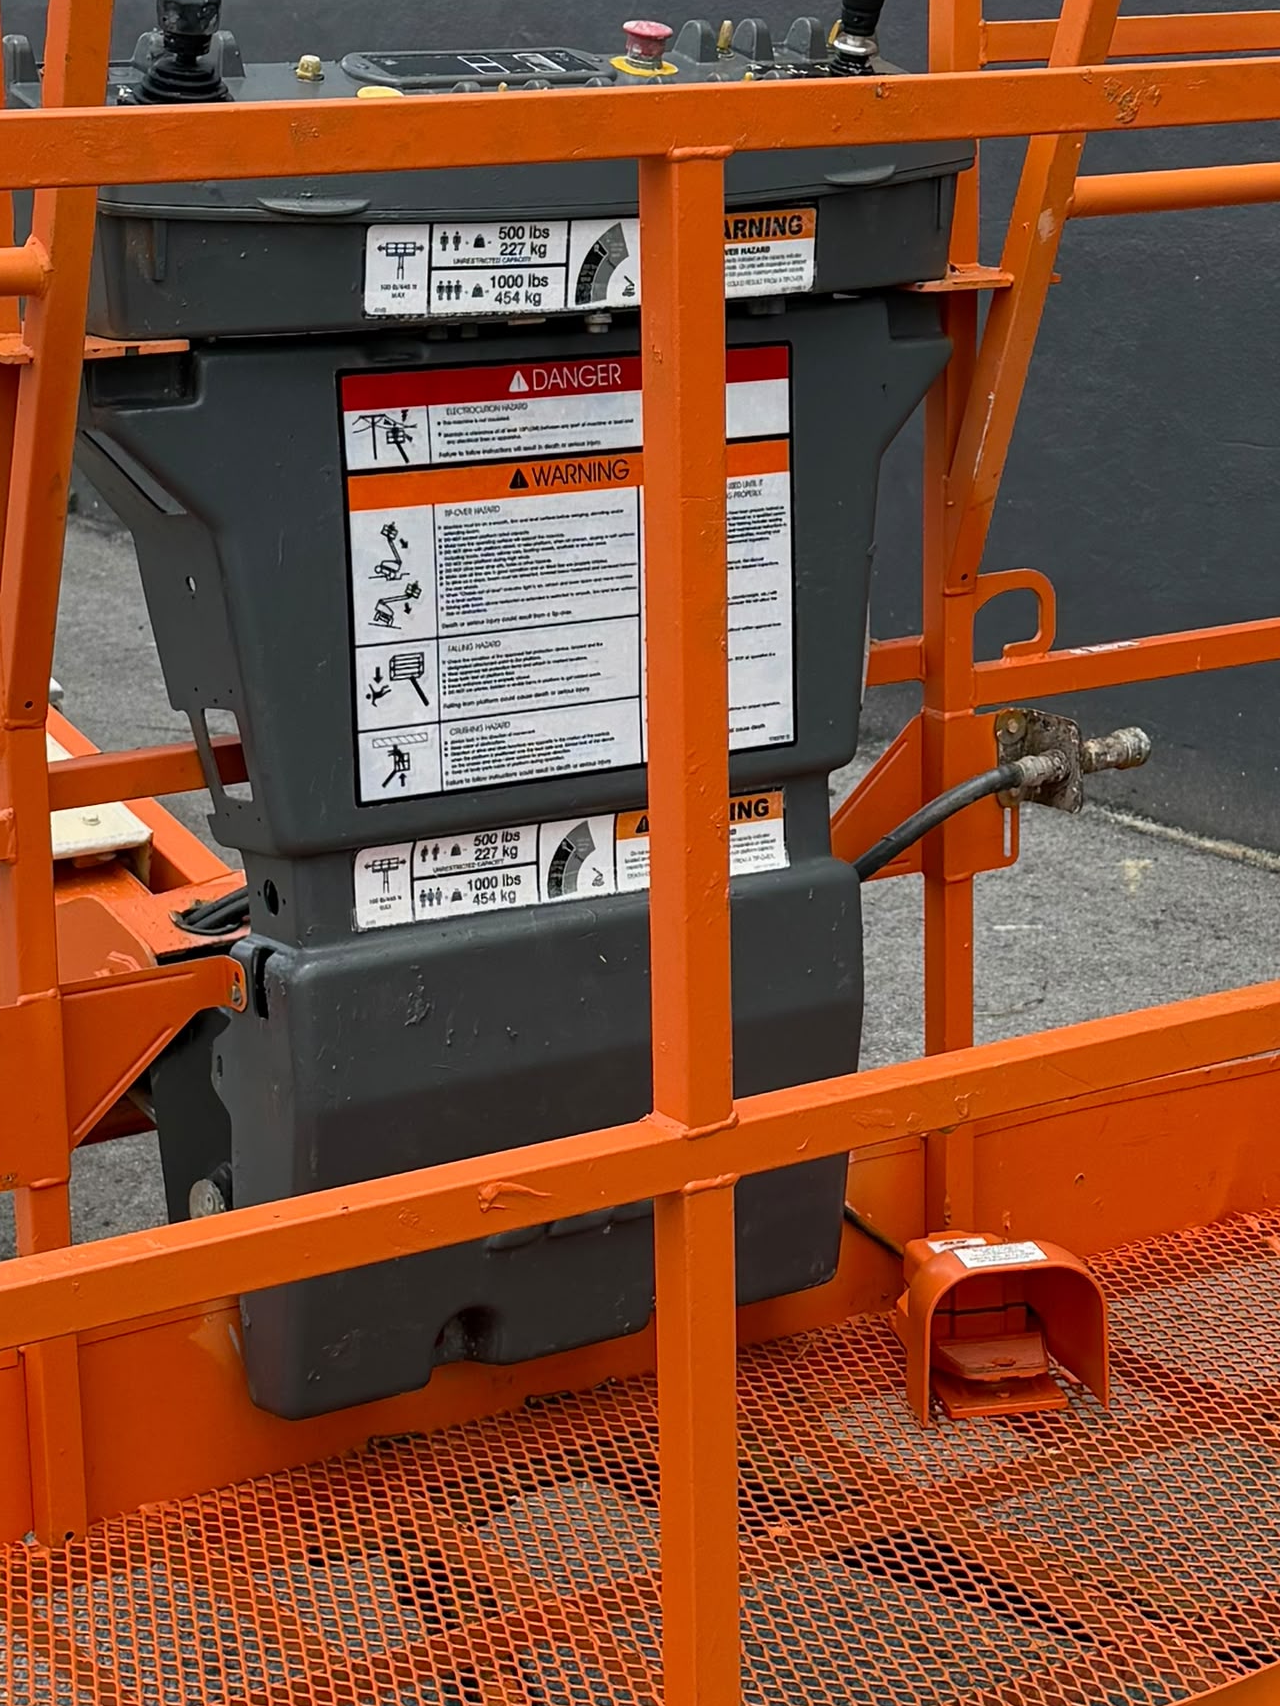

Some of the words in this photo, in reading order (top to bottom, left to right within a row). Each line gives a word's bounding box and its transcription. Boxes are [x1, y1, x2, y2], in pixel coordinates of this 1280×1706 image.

[498, 227, 525, 240] 500
[529, 225, 550, 239] lbs
[724, 215, 803, 240] RNING
[499, 242, 524, 256] 227
[529, 241, 548, 259] kg
[741, 245, 771, 255] HAZARD
[502, 256, 532, 264] CAPACITY
[489, 275, 524, 289] 1000
[527, 274, 549, 287] lbs
[494, 291, 522, 305] 454
[524, 290, 542, 307] kg
[533, 363, 621, 391] DANGER
[446, 403, 500, 416] ELECTROCUTION
[501, 401, 528, 412] HAZARD
[532, 459, 630, 487] WARNING
[473, 504, 500, 515] HAZARD
[448, 642, 473, 653] FALLING
[475, 639, 501, 649] HAZARD
[485, 720, 510, 731] HAZARD
[473, 833, 498, 846] 500
[501, 831, 520, 842] lbs
[474, 847, 498, 861] 227
[502, 845, 518, 860] kg
[468, 876, 498, 892] 1000
[502, 874, 522, 887] lbs
[472, 892, 496, 906] 454
[500, 889, 516, 903] kg
